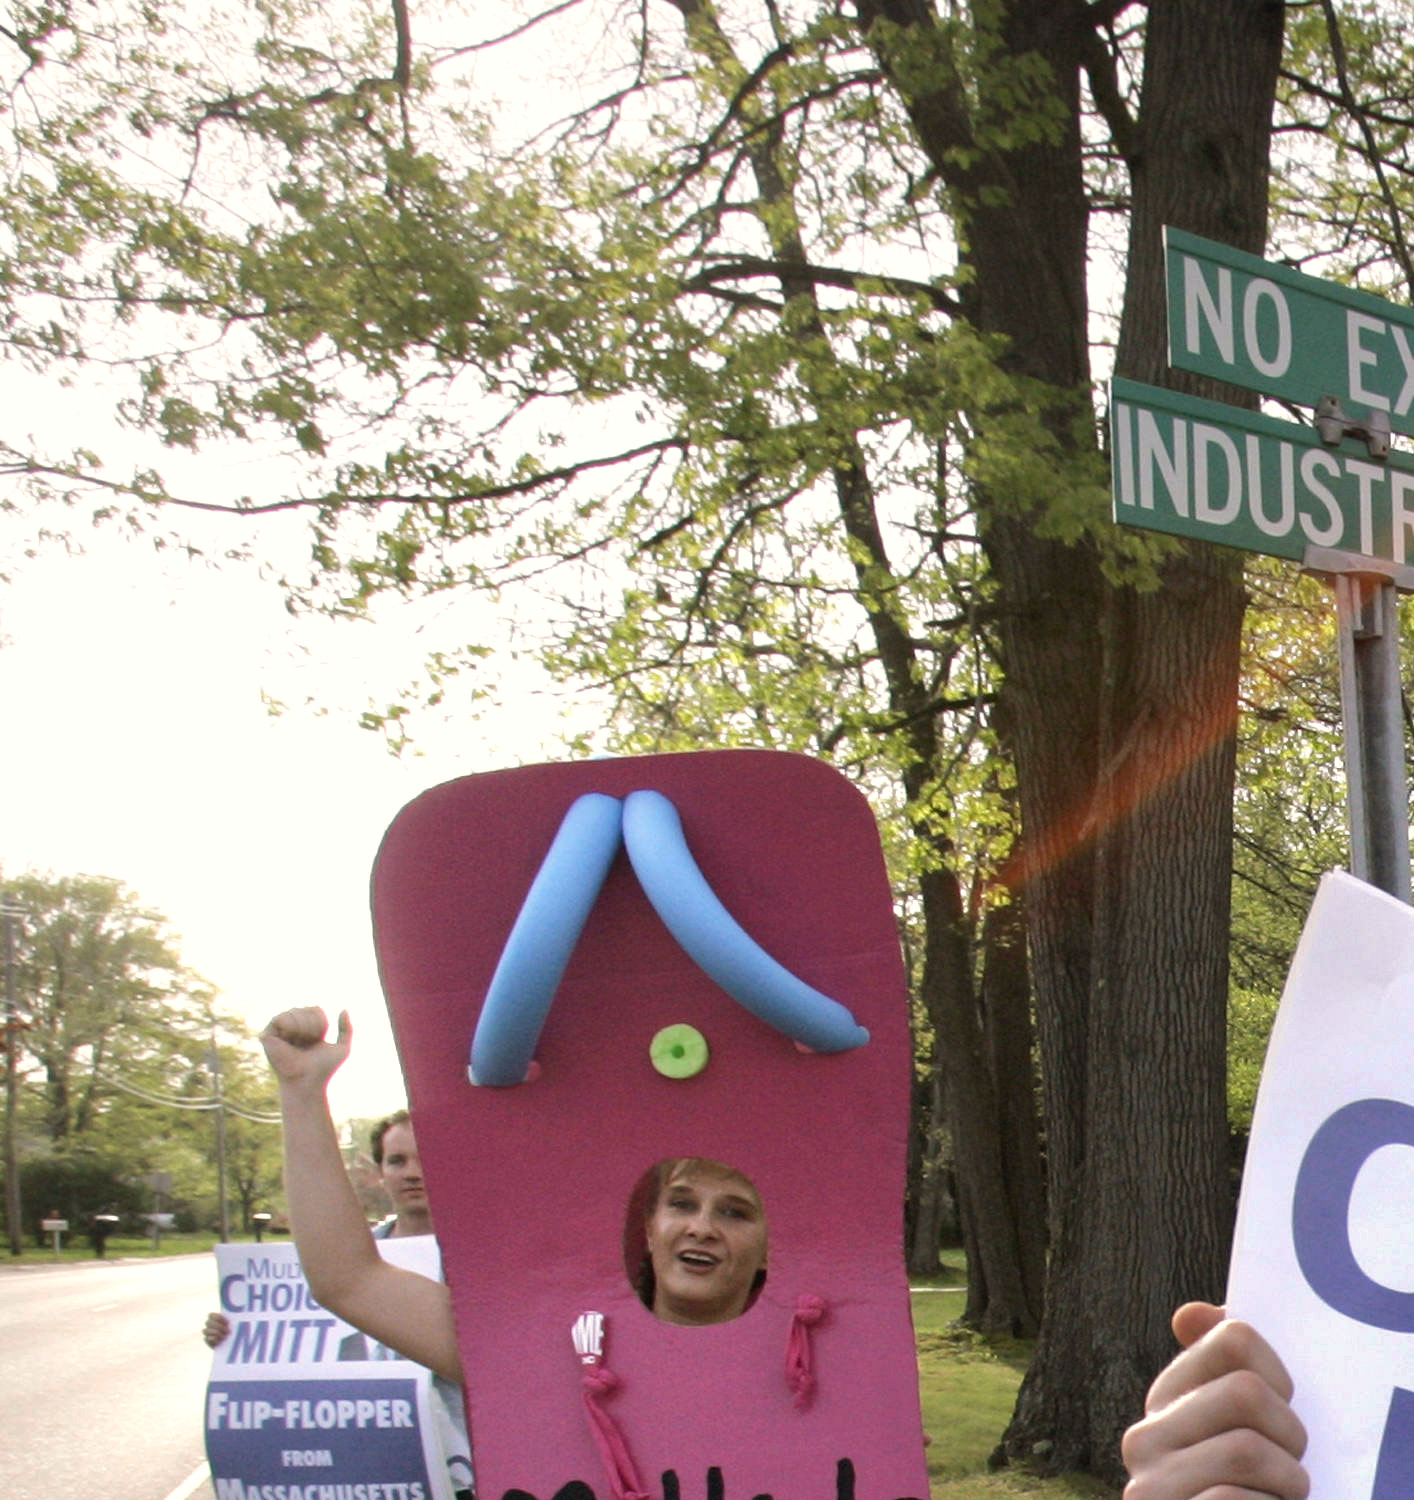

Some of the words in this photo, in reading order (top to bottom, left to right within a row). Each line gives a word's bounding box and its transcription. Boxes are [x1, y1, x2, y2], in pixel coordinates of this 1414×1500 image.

[1183, 256, 1292, 378] NO
[226, 1318, 336, 1363] MITT
[208, 1392, 414, 1430] FLIP-FLOPPER
[281, 1450, 333, 1467] FROM
